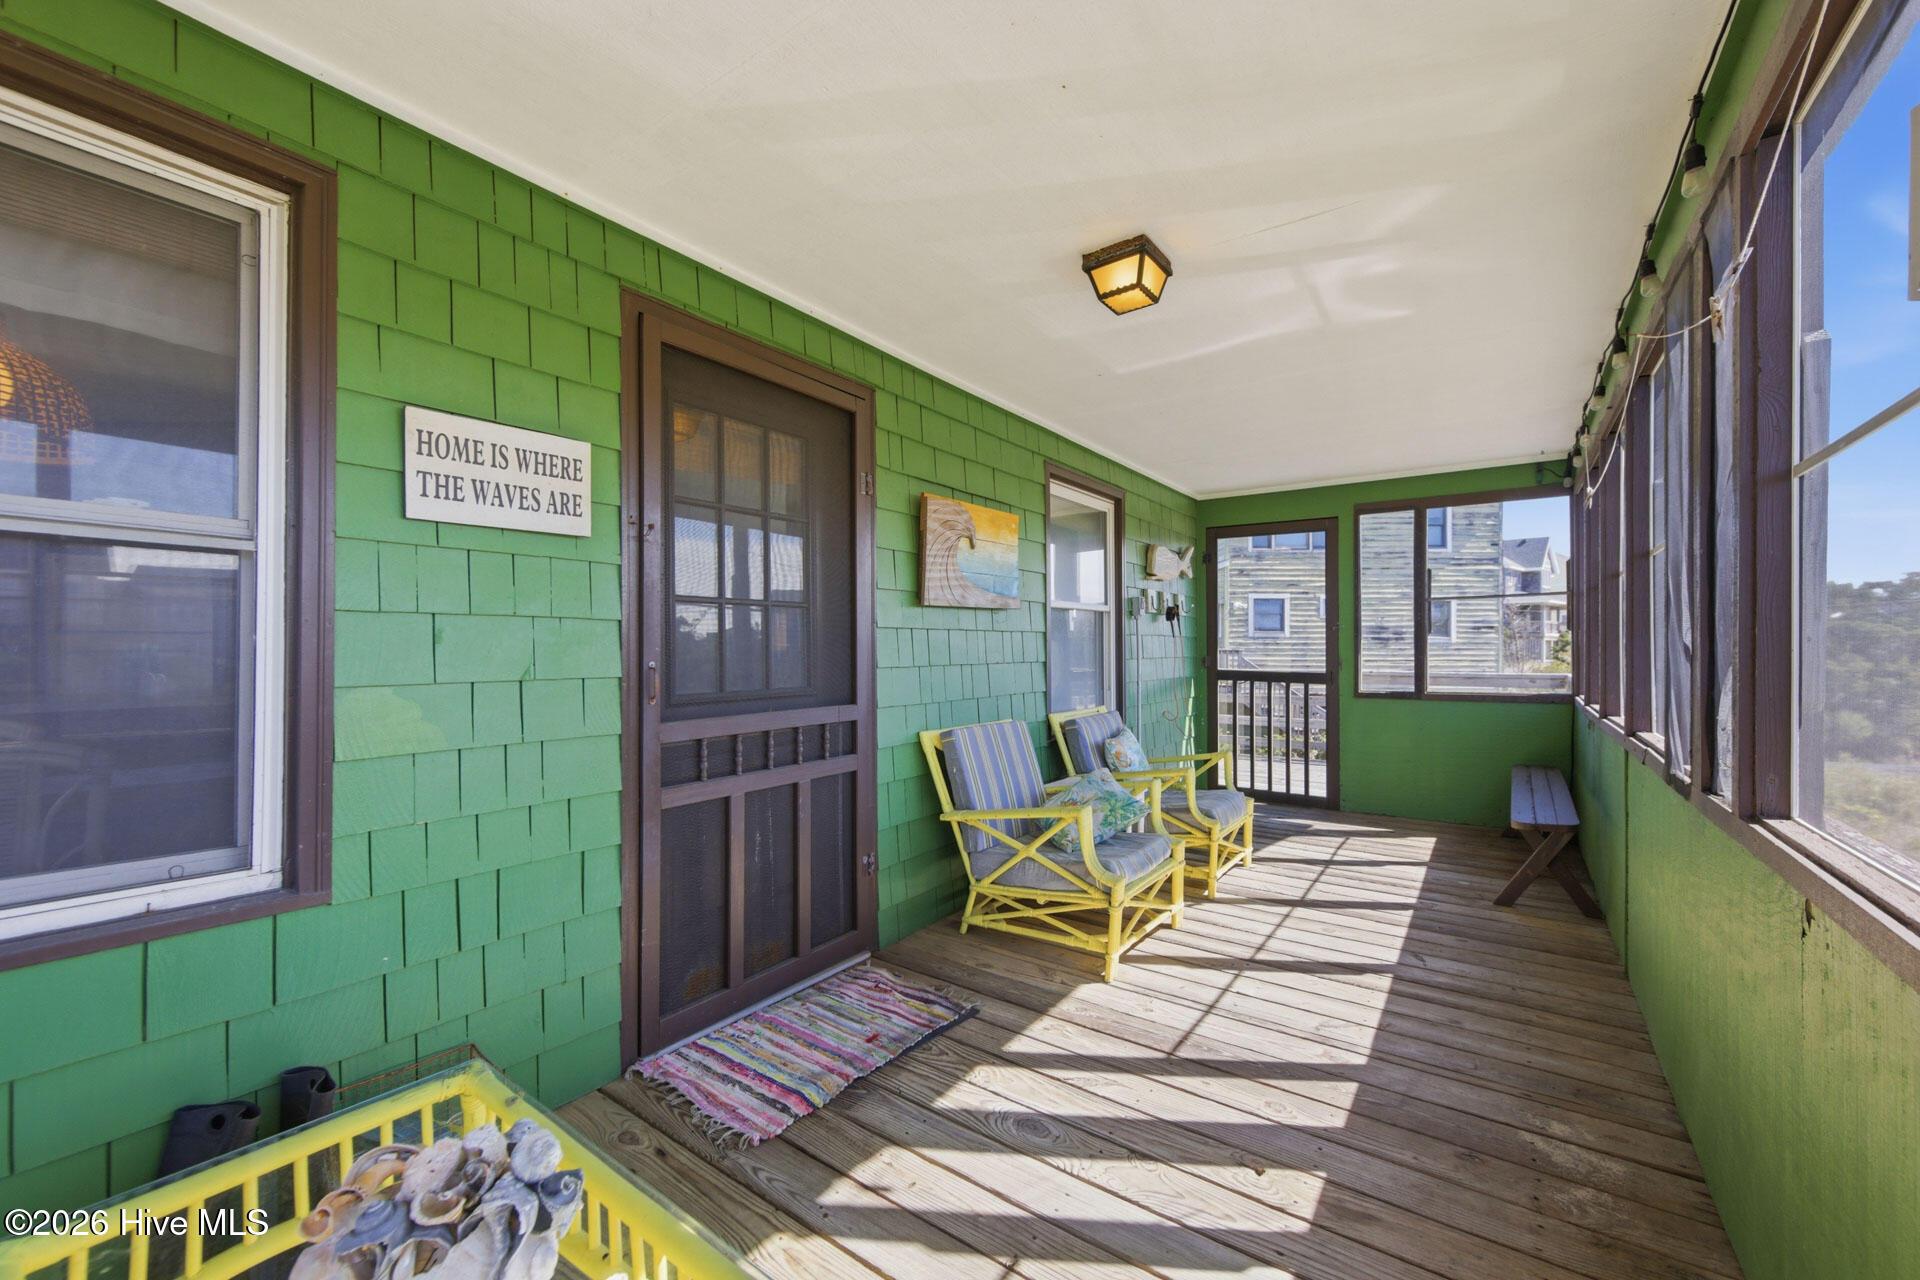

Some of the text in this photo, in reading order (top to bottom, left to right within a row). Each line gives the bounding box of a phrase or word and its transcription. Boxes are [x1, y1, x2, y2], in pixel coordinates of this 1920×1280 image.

[416, 429, 583, 482] HOME IS WHERE
[416, 470, 583, 518] THE WAVES ARE
